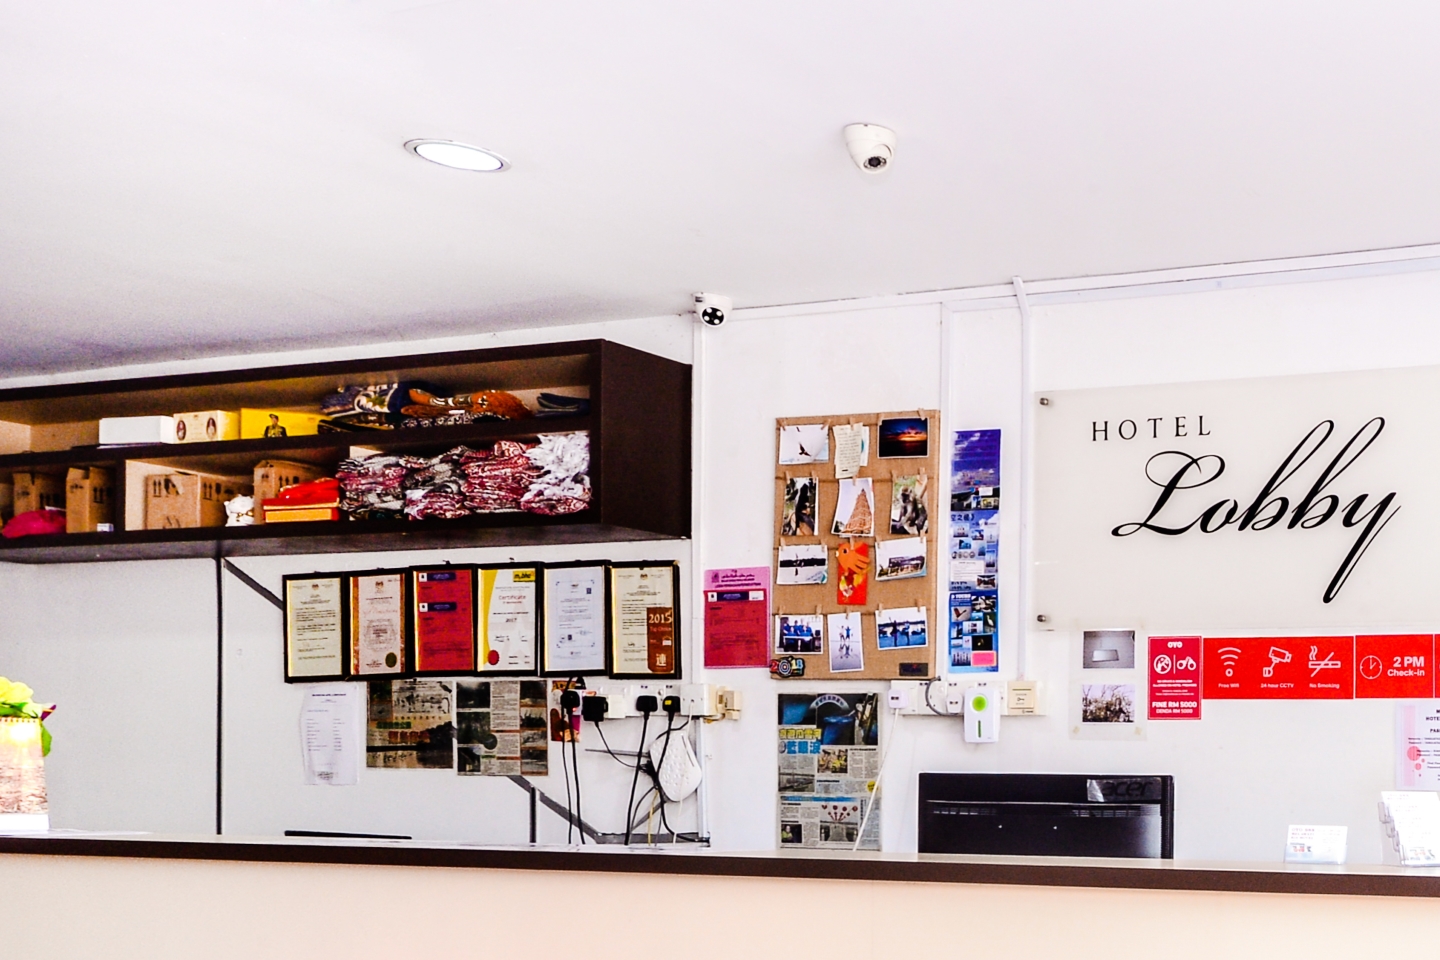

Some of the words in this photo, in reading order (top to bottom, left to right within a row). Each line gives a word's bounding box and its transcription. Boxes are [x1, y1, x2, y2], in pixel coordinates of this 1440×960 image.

[1091, 415, 1211, 442] HOTEL
[1111, 416, 1402, 604] Lobby
[648, 610, 673, 624] 2015
[1393, 656, 1402, 667] 2
[1403, 656, 1425, 667] PM
[1387, 668, 1425, 677] Check-in
[1102, 781, 1153, 797] acer
